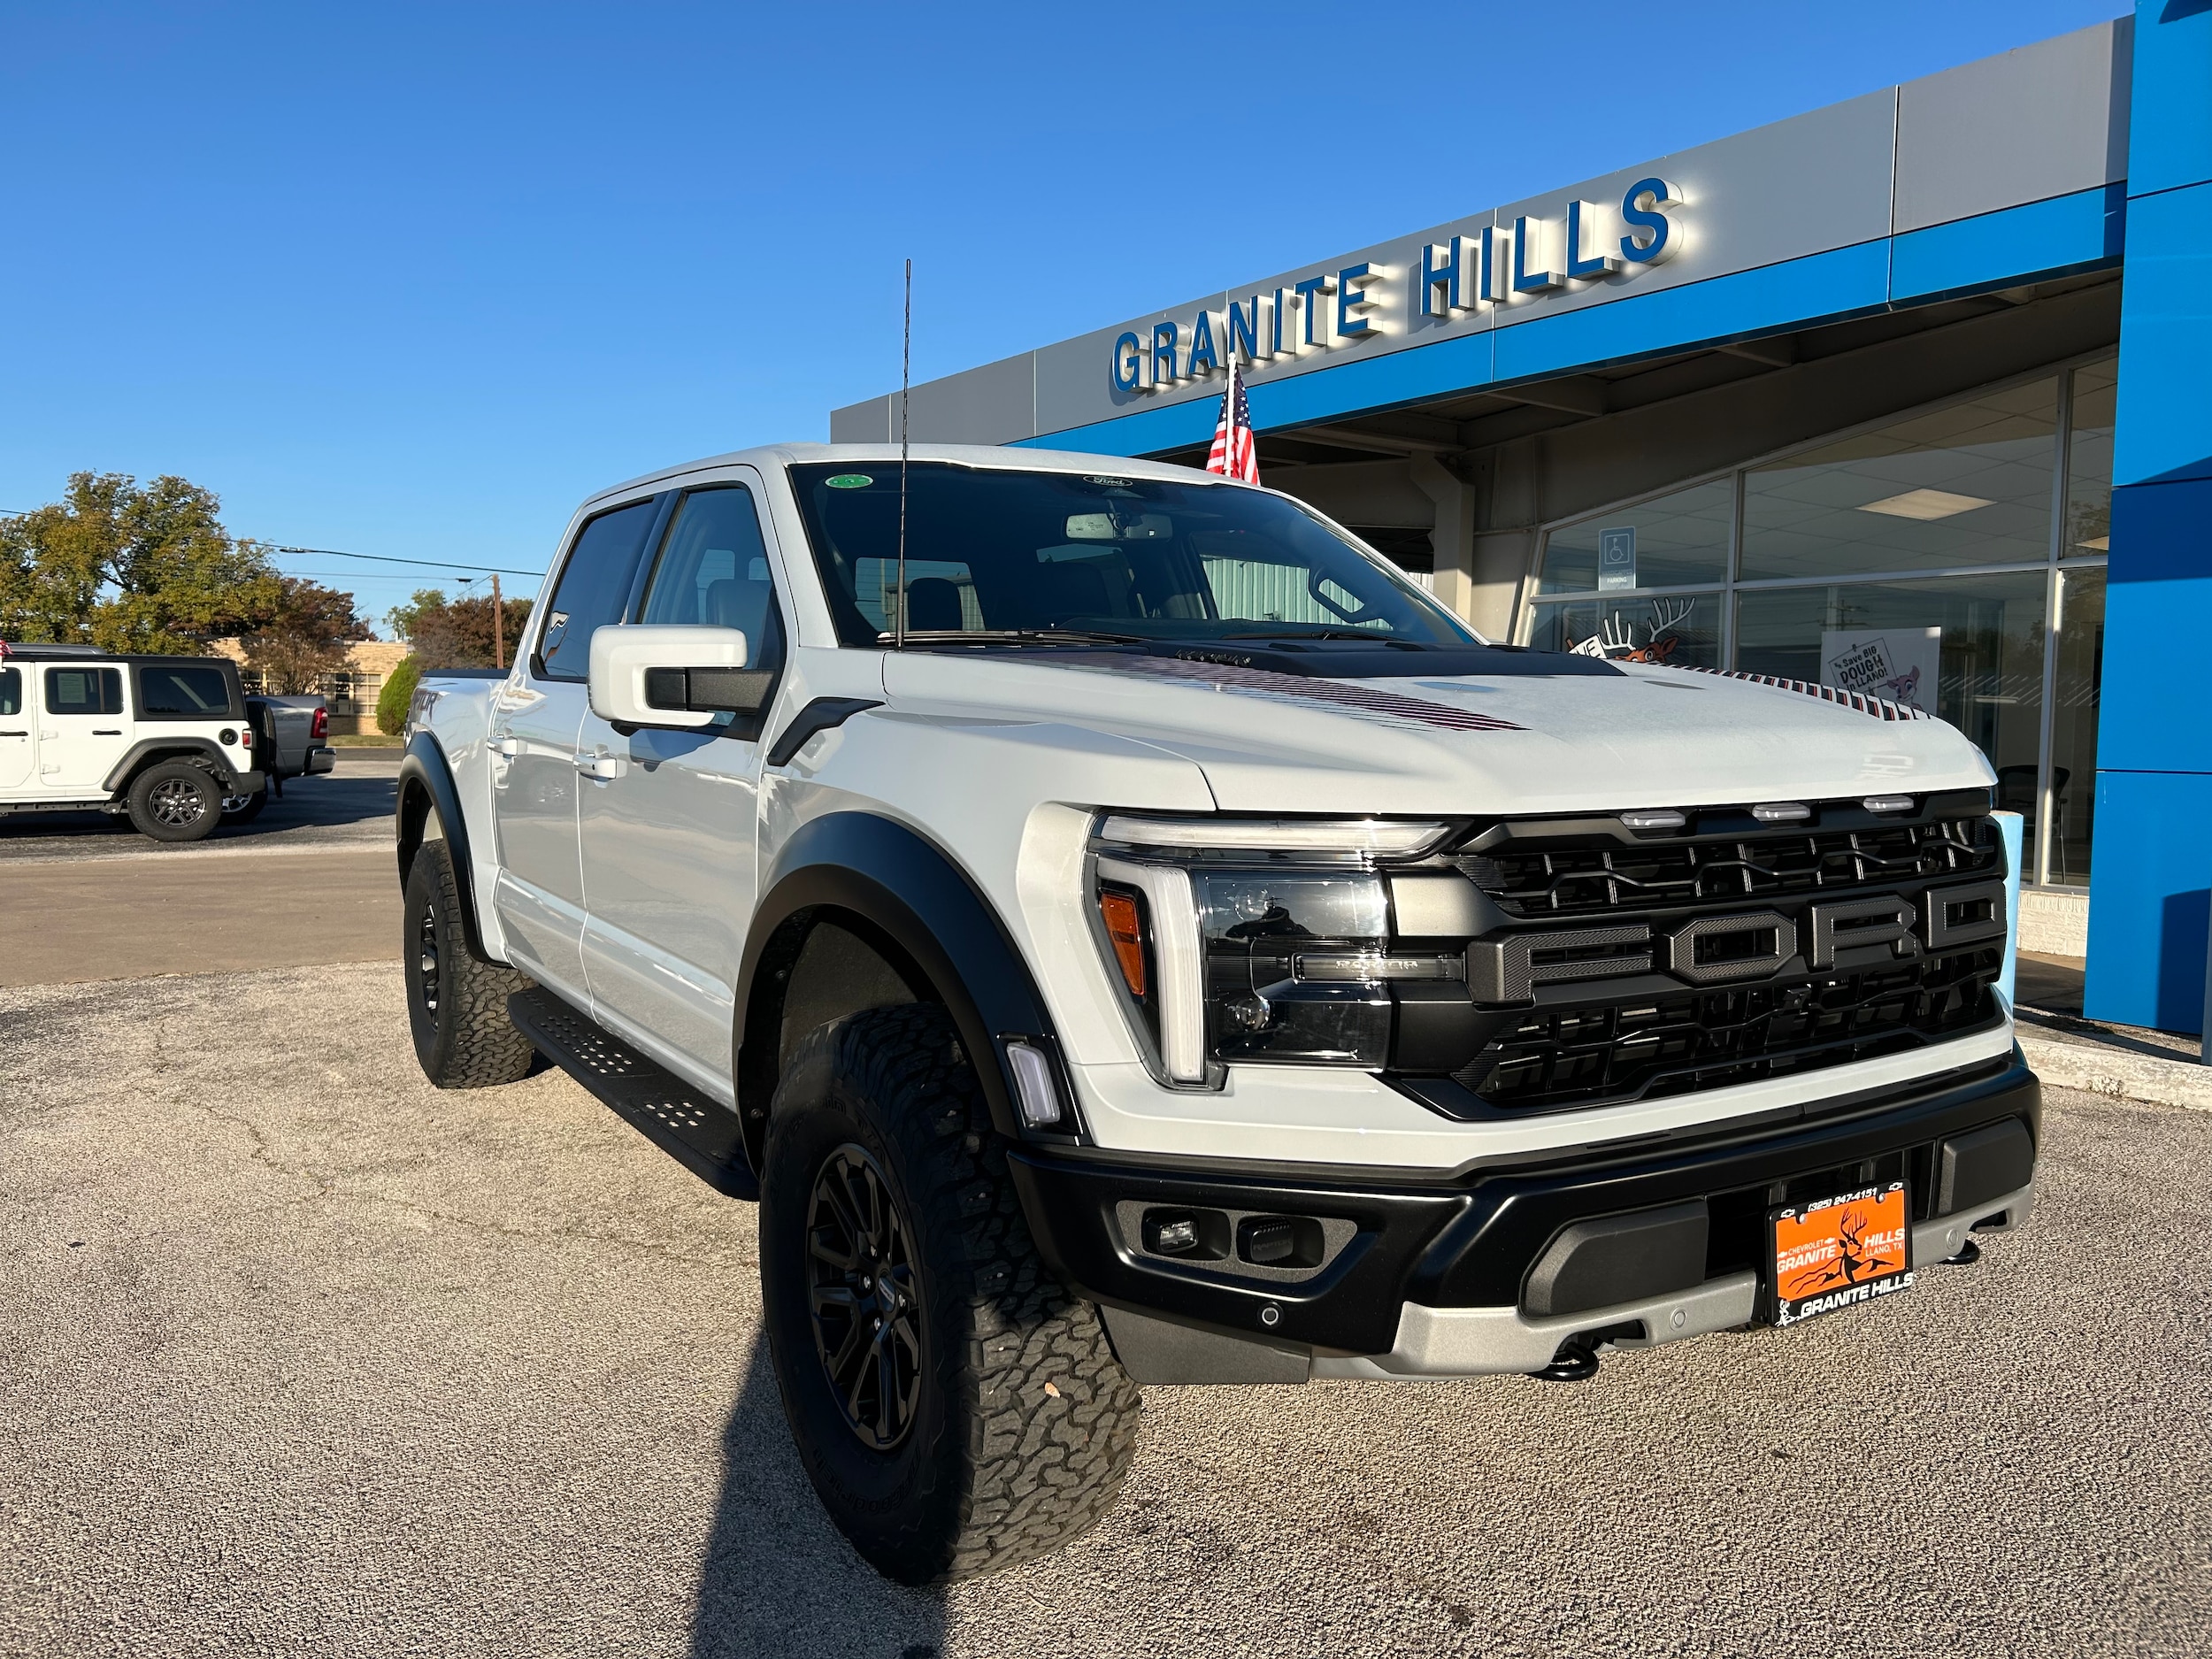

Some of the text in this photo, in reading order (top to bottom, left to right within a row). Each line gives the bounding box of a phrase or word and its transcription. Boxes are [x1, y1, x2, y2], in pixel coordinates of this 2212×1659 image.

[1110, 177, 1684, 392] GRANITE HILLS
[1092, 476, 1126, 486] Ford
[1842, 645, 1877, 667] Save BIG
[1840, 654, 1885, 684] DOUGH
[1855, 666, 1888, 687] LLANO!
[1465, 883, 2007, 1010] FORD
[1807, 1187, 1878, 1213] (325) 247-4151
[1787, 1239, 1824, 1256] CHEVROLET
[1863, 1228, 1906, 1249] HILLS
[1865, 1241, 1903, 1257] LLANO, TX
[1777, 1244, 1837, 1274] GRANITE
[1800, 1271, 1915, 1318] GRANITE HILLS
